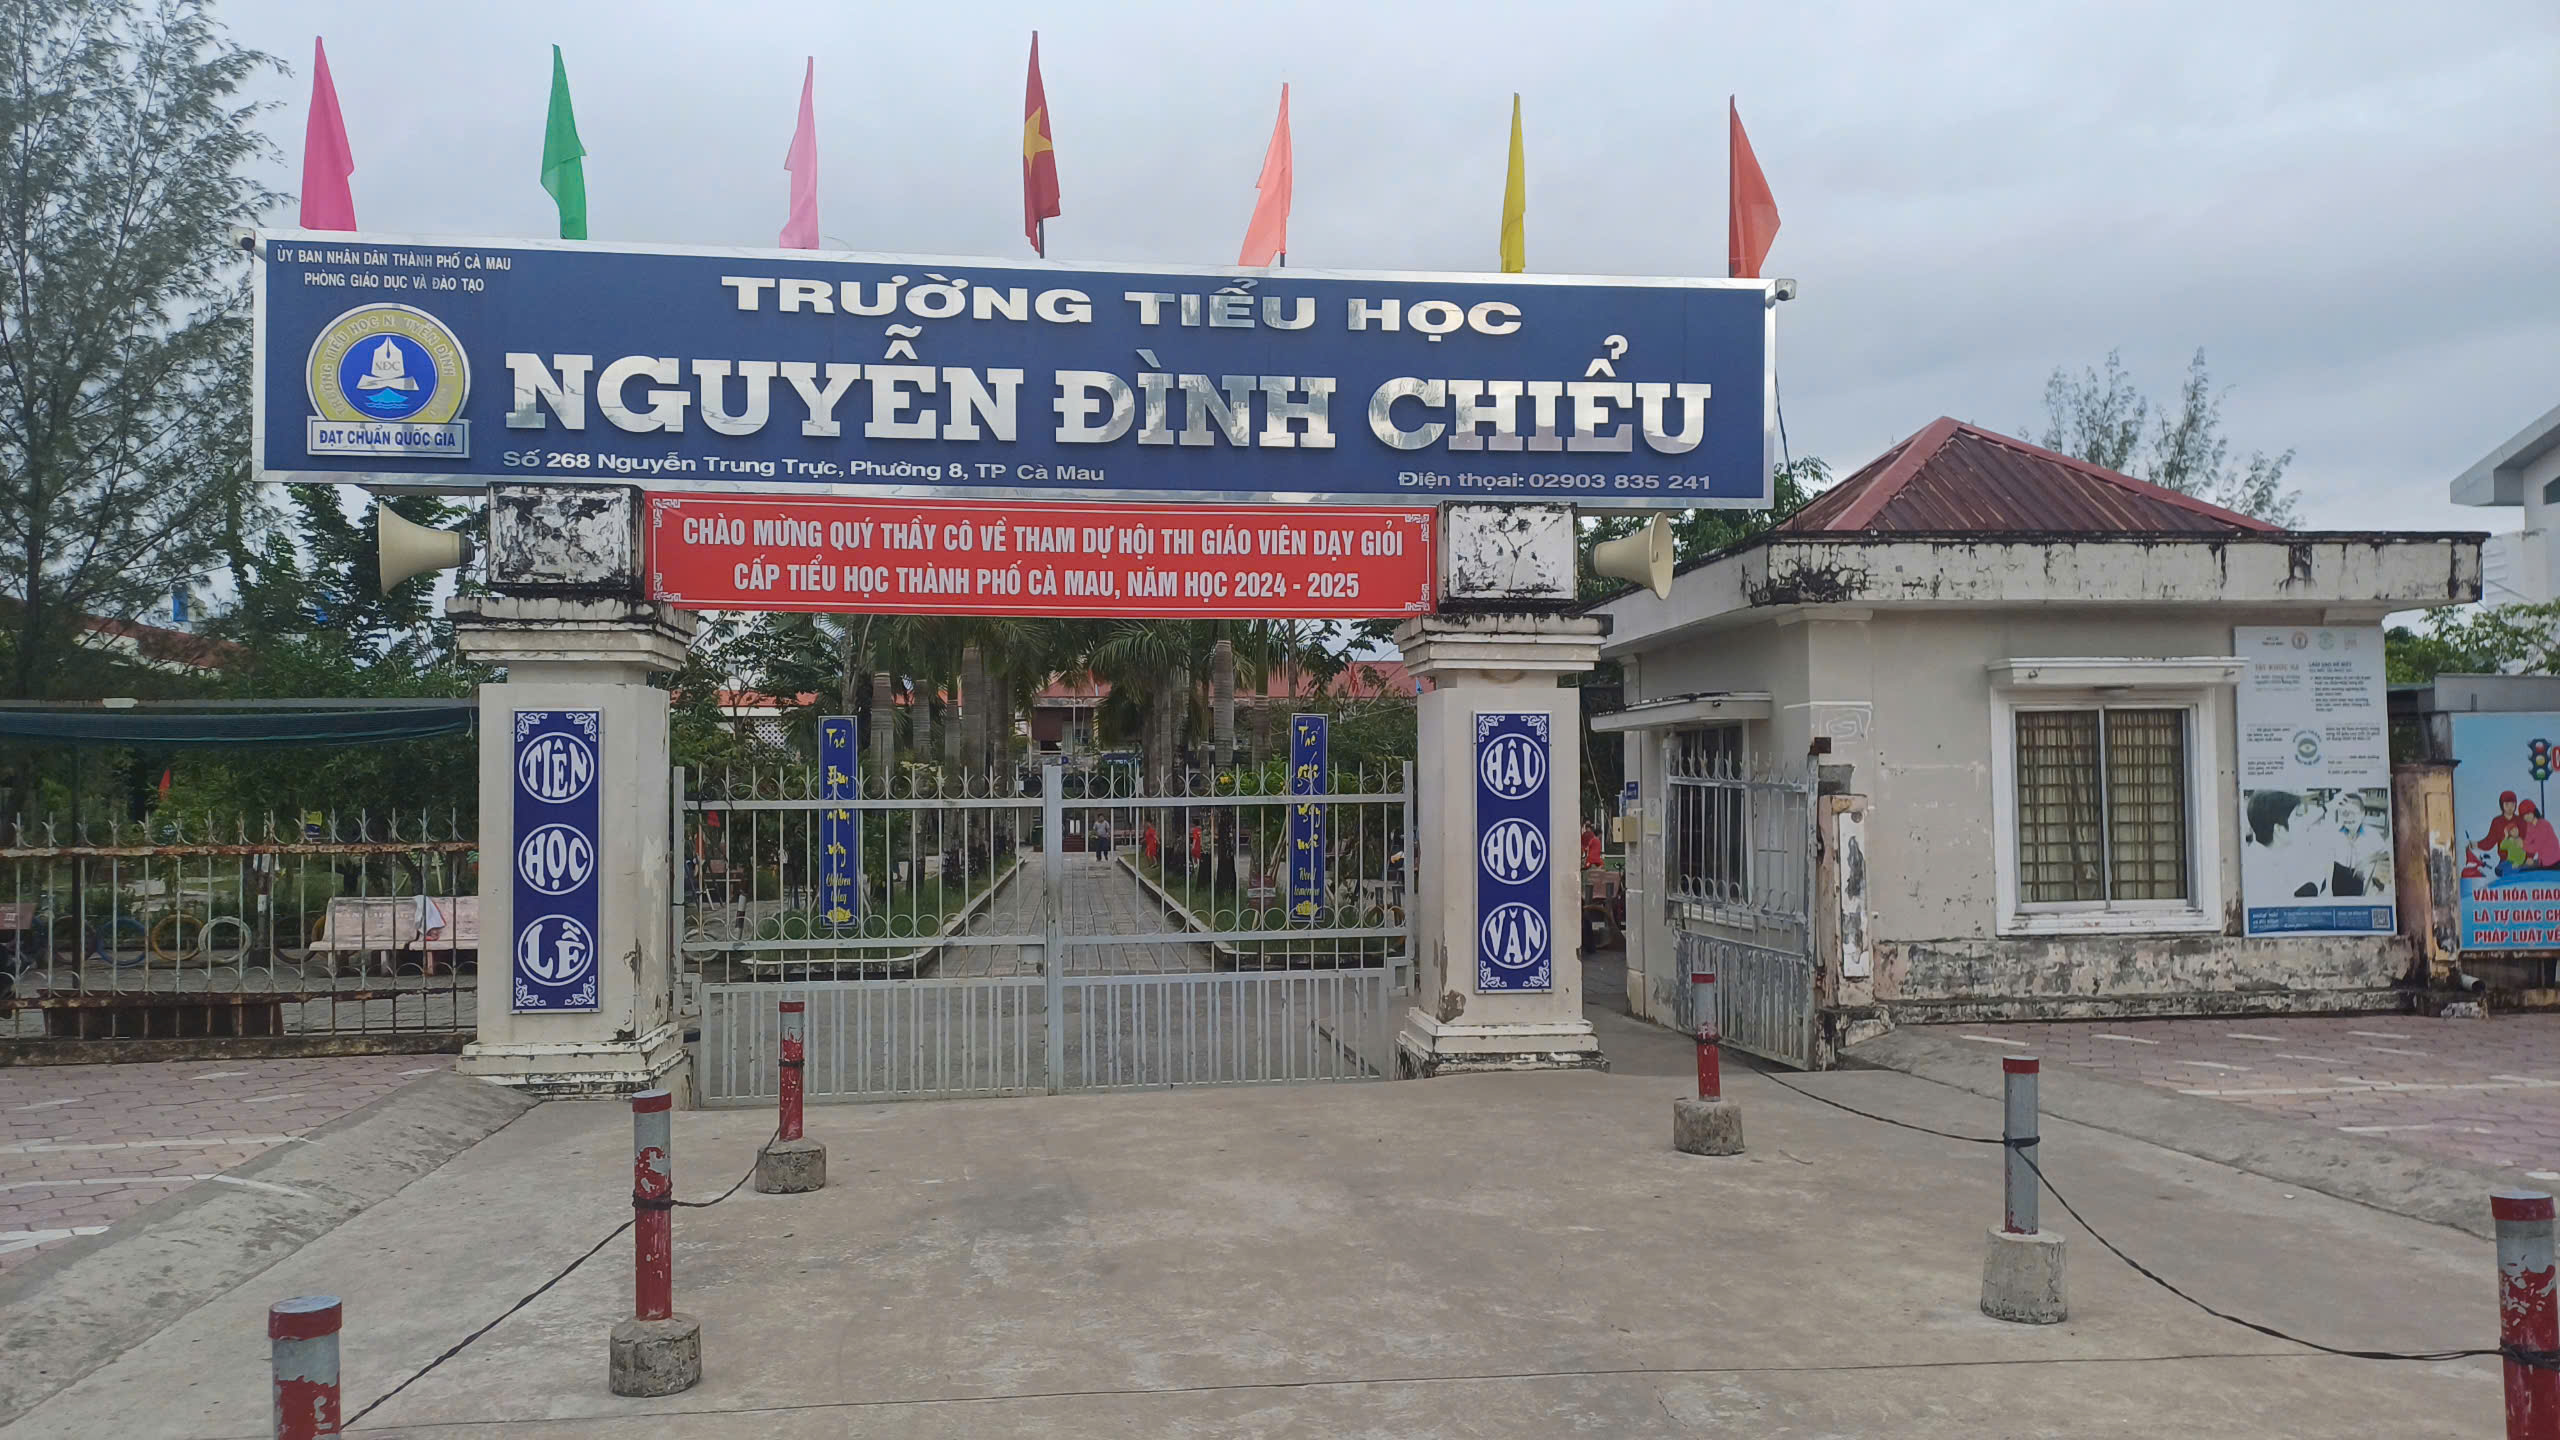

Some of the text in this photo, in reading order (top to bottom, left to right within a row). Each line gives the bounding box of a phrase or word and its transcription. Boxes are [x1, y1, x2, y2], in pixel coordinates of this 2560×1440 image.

[277, 244, 511, 270] ỦY BAN NHÂN DÂN THÀNH PHỐ CÀ MAU
[304, 269, 484, 293] PHÒNG GIÁO DỤC VÀ ĐÀO TẠO
[722, 273, 1522, 341] TRƯỜNG TIỂU HỌC
[505, 324, 1712, 455] NGUYỄN ĐÌNH CHIỂU
[320, 425, 456, 447] ĐẠT CHUẨN QUỐC GIA
[503, 449, 1105, 481] Số 268 Nguyễn Trung Trực, Phường 8, TP Cà Mau
[1398, 471, 1450, 489] Điện
[1529, 474, 1606, 489] 02903
[1614, 474, 1660, 489] 835
[1668, 475, 1711, 489] 241
[683, 513, 1403, 561] CHÀO MỪNG QUÝ THẦY CÔ VỀ THAM DỰ HỘI THI GIÁO VIÊN DẠY GIỎI
[734, 554, 779, 590] CẤP
[787, 554, 835, 591] TIỂU
[844, 565, 889, 598] HỌC
[896, 562, 969, 594] THÀNH
[977, 559, 1021, 595] PHỐ
[1028, 564, 1057, 596] CÀ
[1065, 569, 1120, 599] MAU,
[1128, 566, 1177, 597] NĂM
[1184, 572, 1228, 603] HỌC
[1234, 572, 1287, 597] 2024
[1307, 573, 1359, 598] 2025
[525, 738, 587, 798] TIÊN
[1486, 738, 1540, 795] HẬU
[525, 829, 588, 890] HỌC
[1486, 823, 1542, 880] HỌC
[2502, 886, 2528, 901] HÓA
[2512, 907, 2542, 923] GIÁC
[525, 921, 586, 979] LỄ
[1487, 908, 1542, 964] VĂN
[2474, 928, 2508, 944] PHÁP
[2512, 928, 2543, 946] LUẬT
